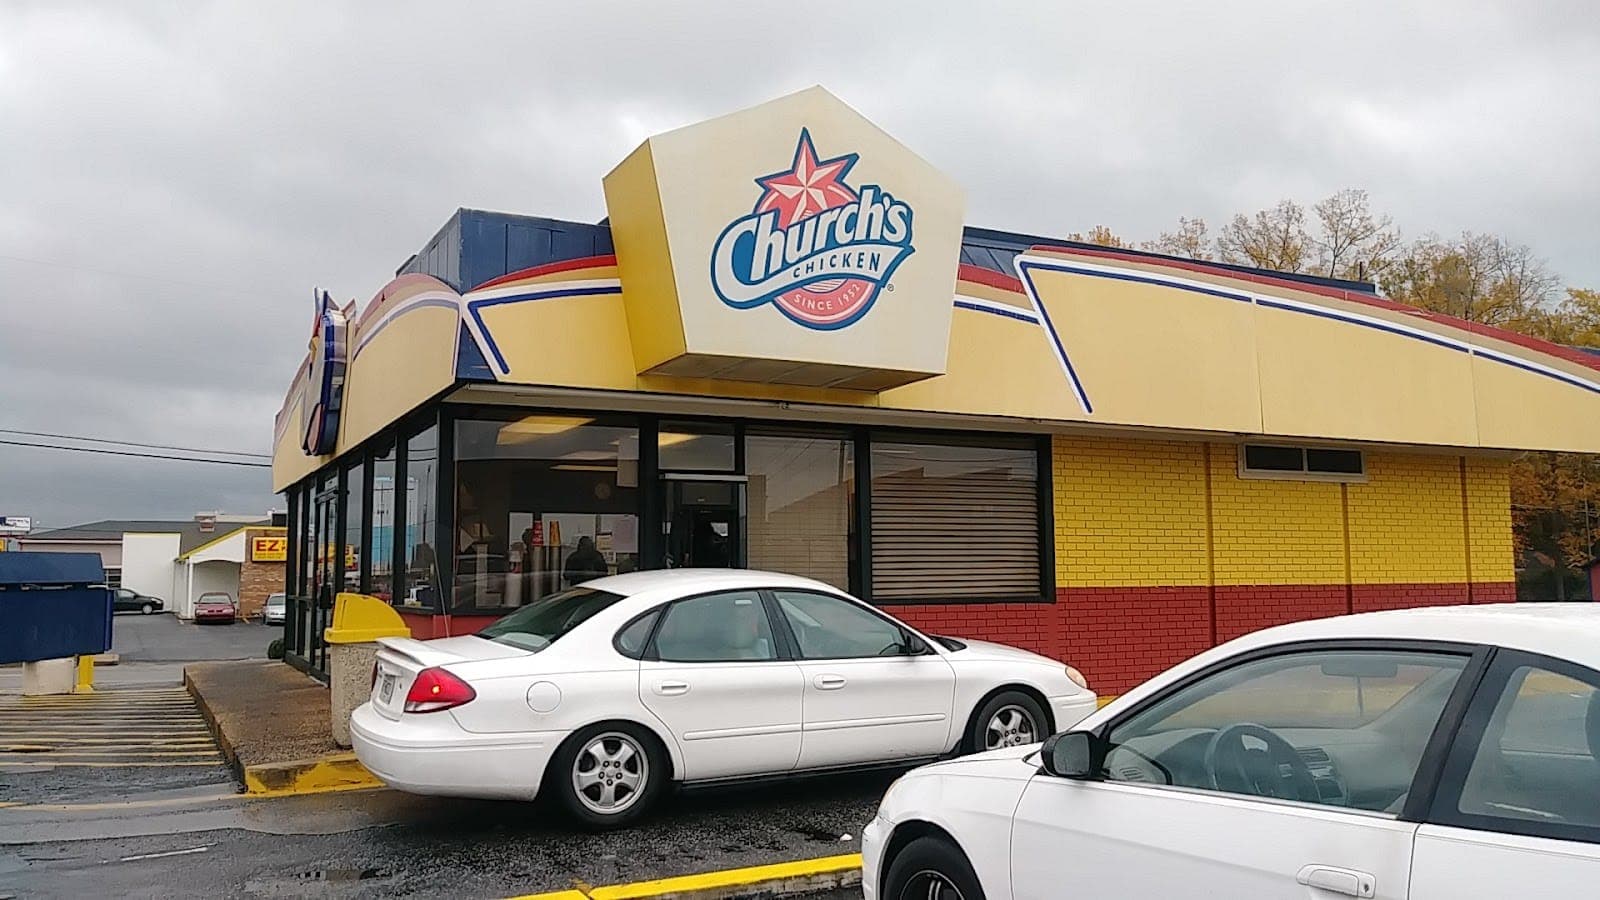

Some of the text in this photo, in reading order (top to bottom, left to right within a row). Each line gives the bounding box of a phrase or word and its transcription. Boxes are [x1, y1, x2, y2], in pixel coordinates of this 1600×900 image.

[713, 186, 909, 304] Church's
[793, 252, 881, 278] CHICKEN
[793, 283, 861, 311] SINCE 1952
